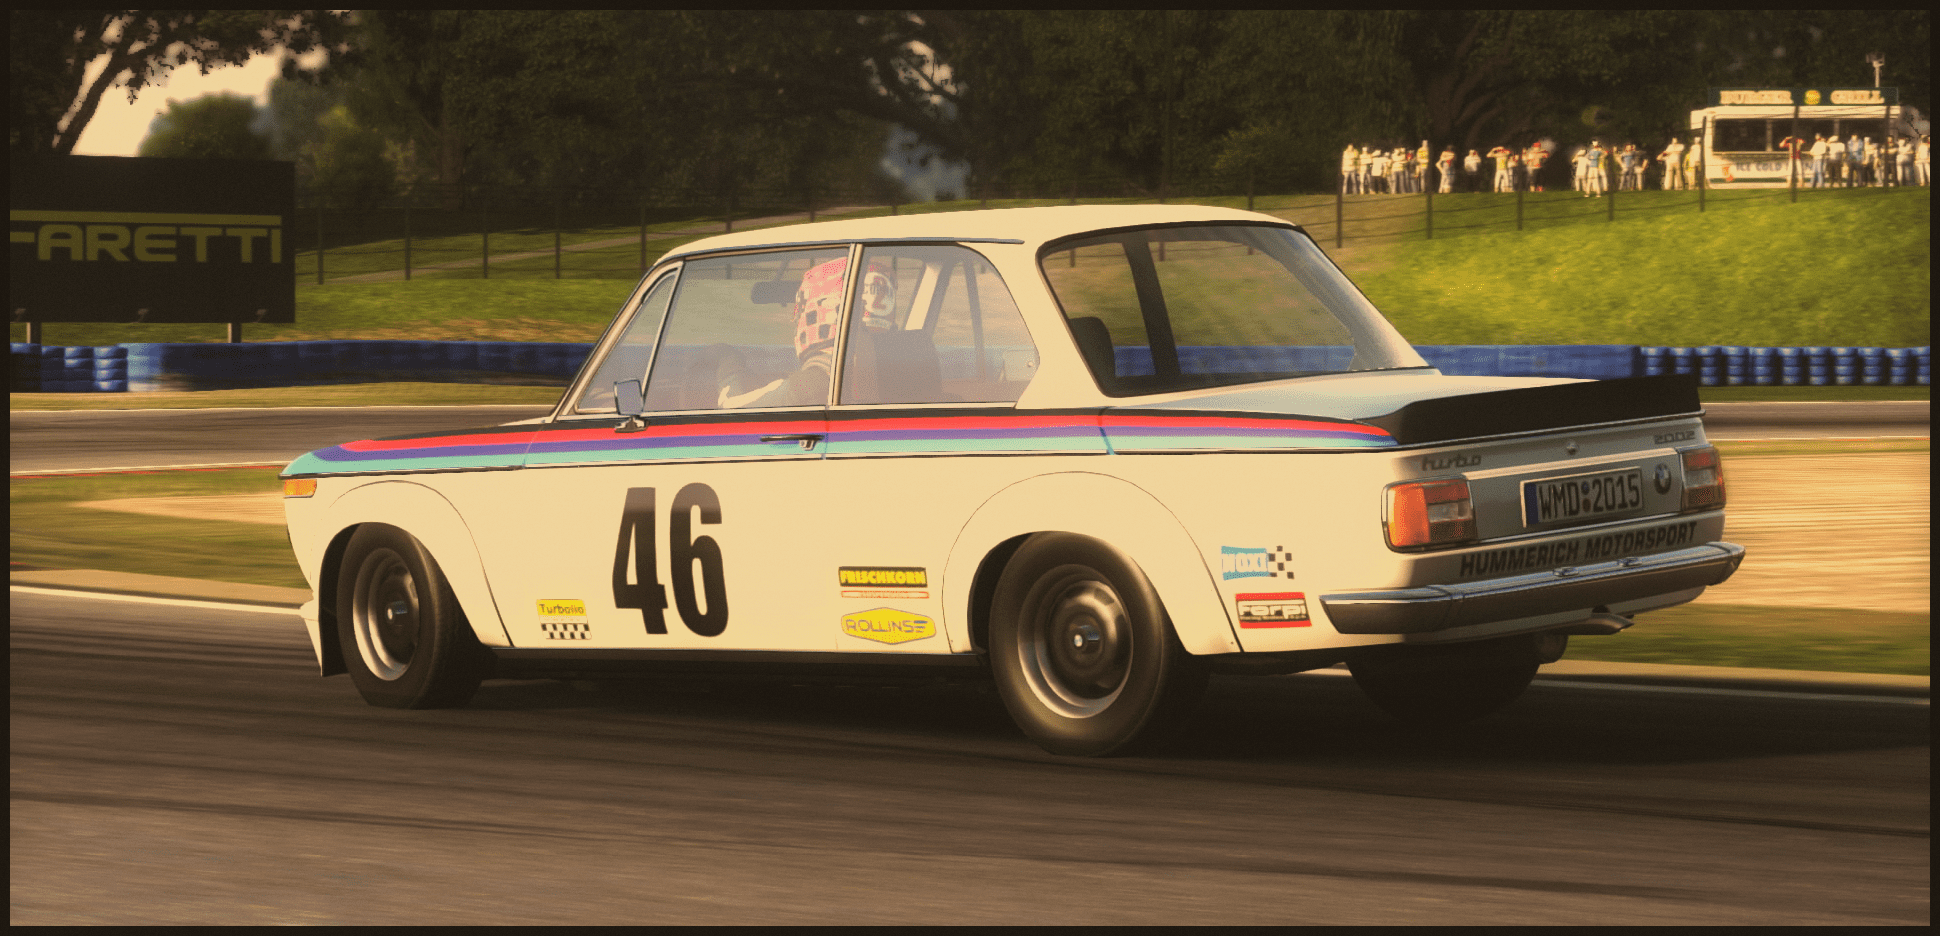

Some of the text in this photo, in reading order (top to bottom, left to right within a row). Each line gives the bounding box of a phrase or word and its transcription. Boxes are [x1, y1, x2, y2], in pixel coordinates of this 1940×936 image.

[1654, 430, 1696, 444] 2002
[1422, 454, 1481, 471] turbo
[1538, 473, 1640, 521] WMD 2015
[612, 482, 728, 637] 46
[1460, 521, 1698, 578] HUMMERICH MOTORSPORT
[840, 571, 926, 584] FRISCHKORN
